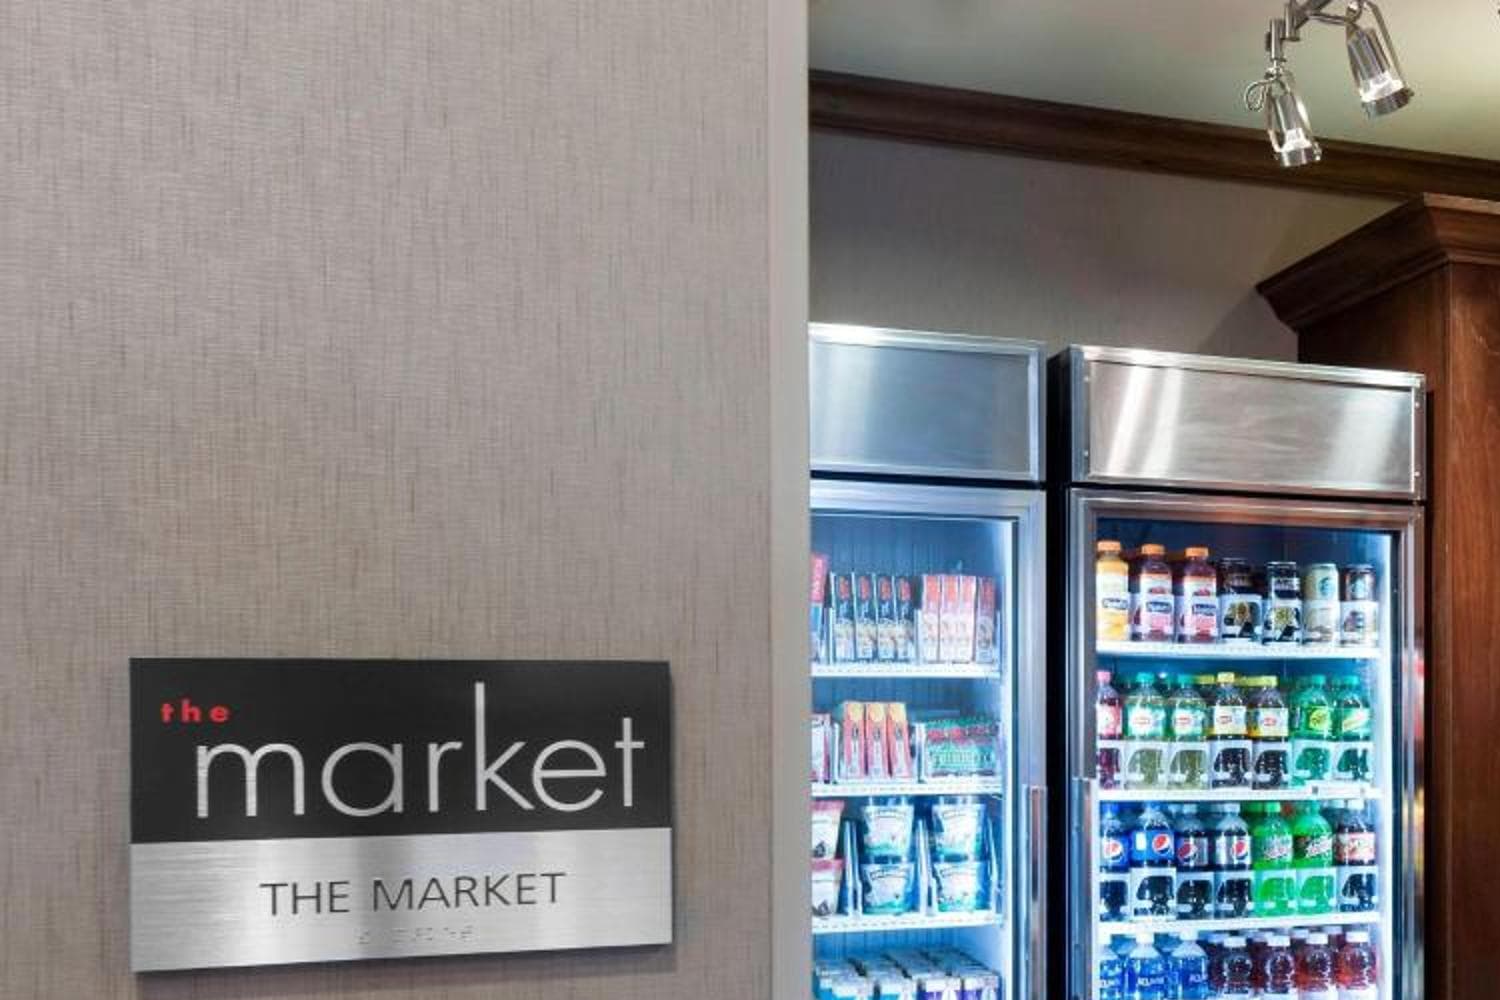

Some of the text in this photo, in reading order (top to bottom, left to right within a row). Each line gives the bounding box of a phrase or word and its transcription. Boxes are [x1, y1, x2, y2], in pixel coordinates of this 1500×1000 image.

[160, 699, 231, 723] the
[196, 682, 646, 818] market
[260, 873, 567, 916] THE MARKET
